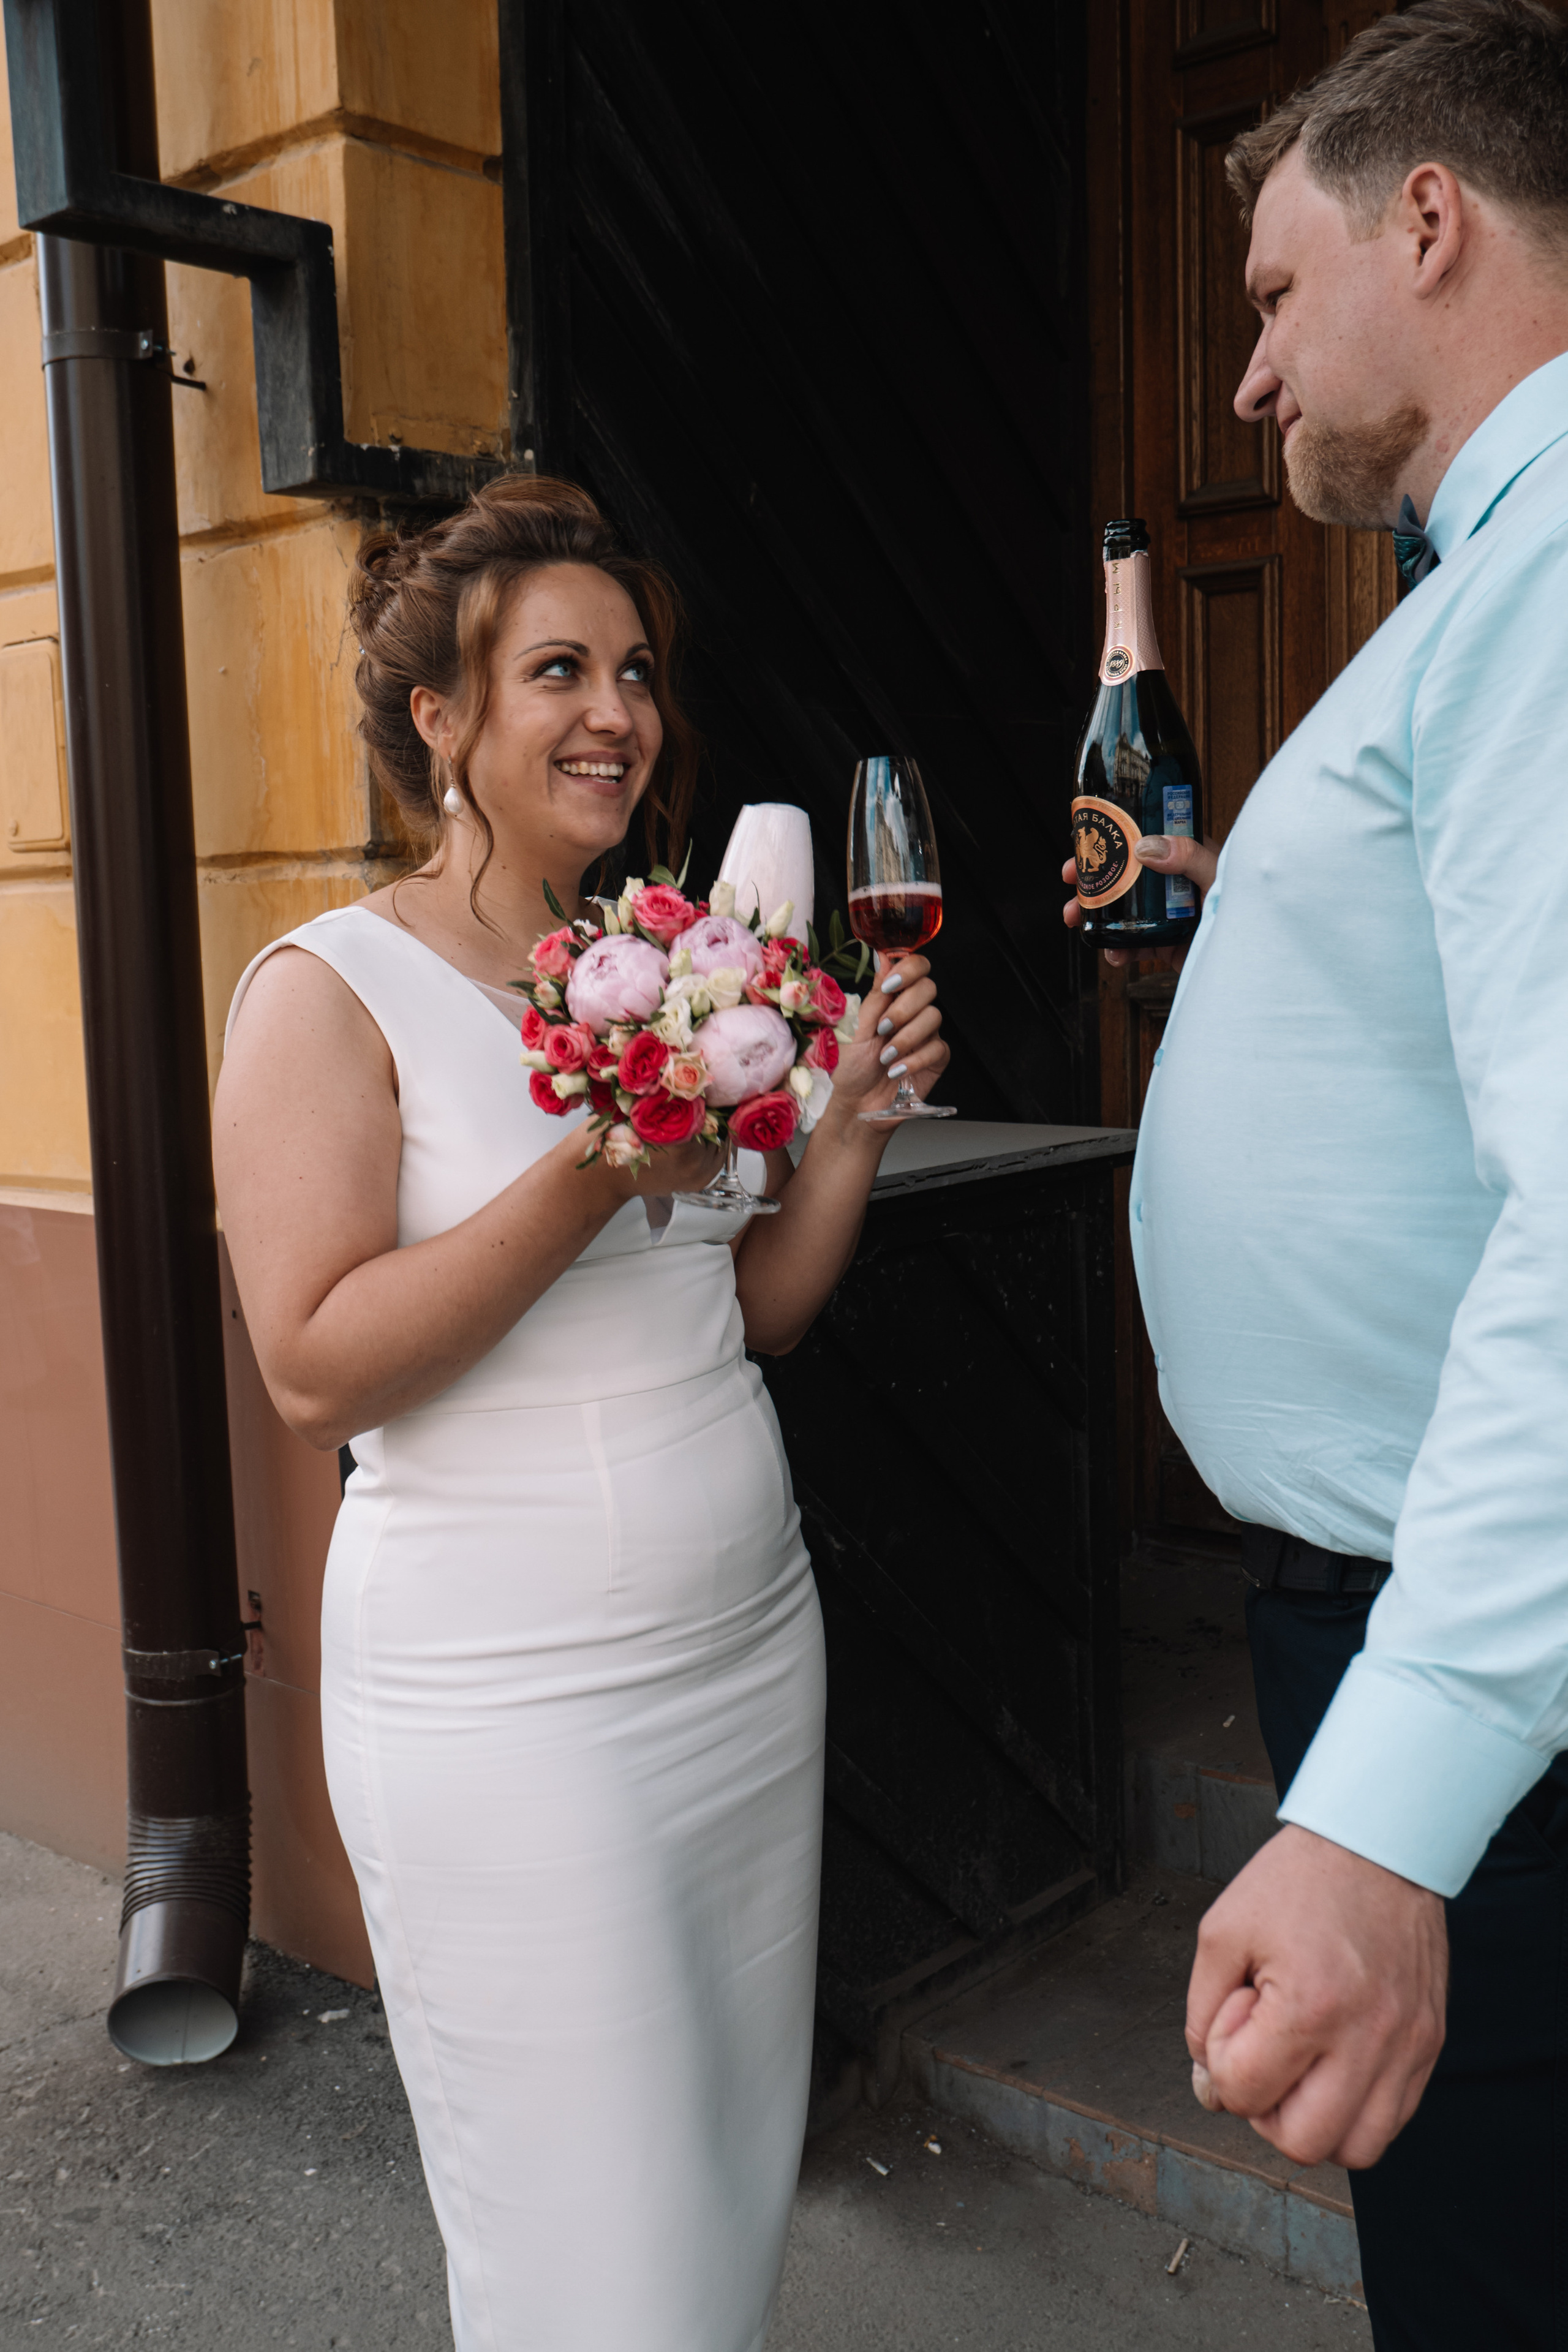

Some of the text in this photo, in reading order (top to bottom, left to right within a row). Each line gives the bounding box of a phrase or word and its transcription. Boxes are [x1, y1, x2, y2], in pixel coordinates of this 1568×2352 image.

[1109, 659, 1123, 669] 1889
[1092, 813, 1123, 850] БАЛКА
[1095, 862, 1118, 888] РОЗОВОЕ
